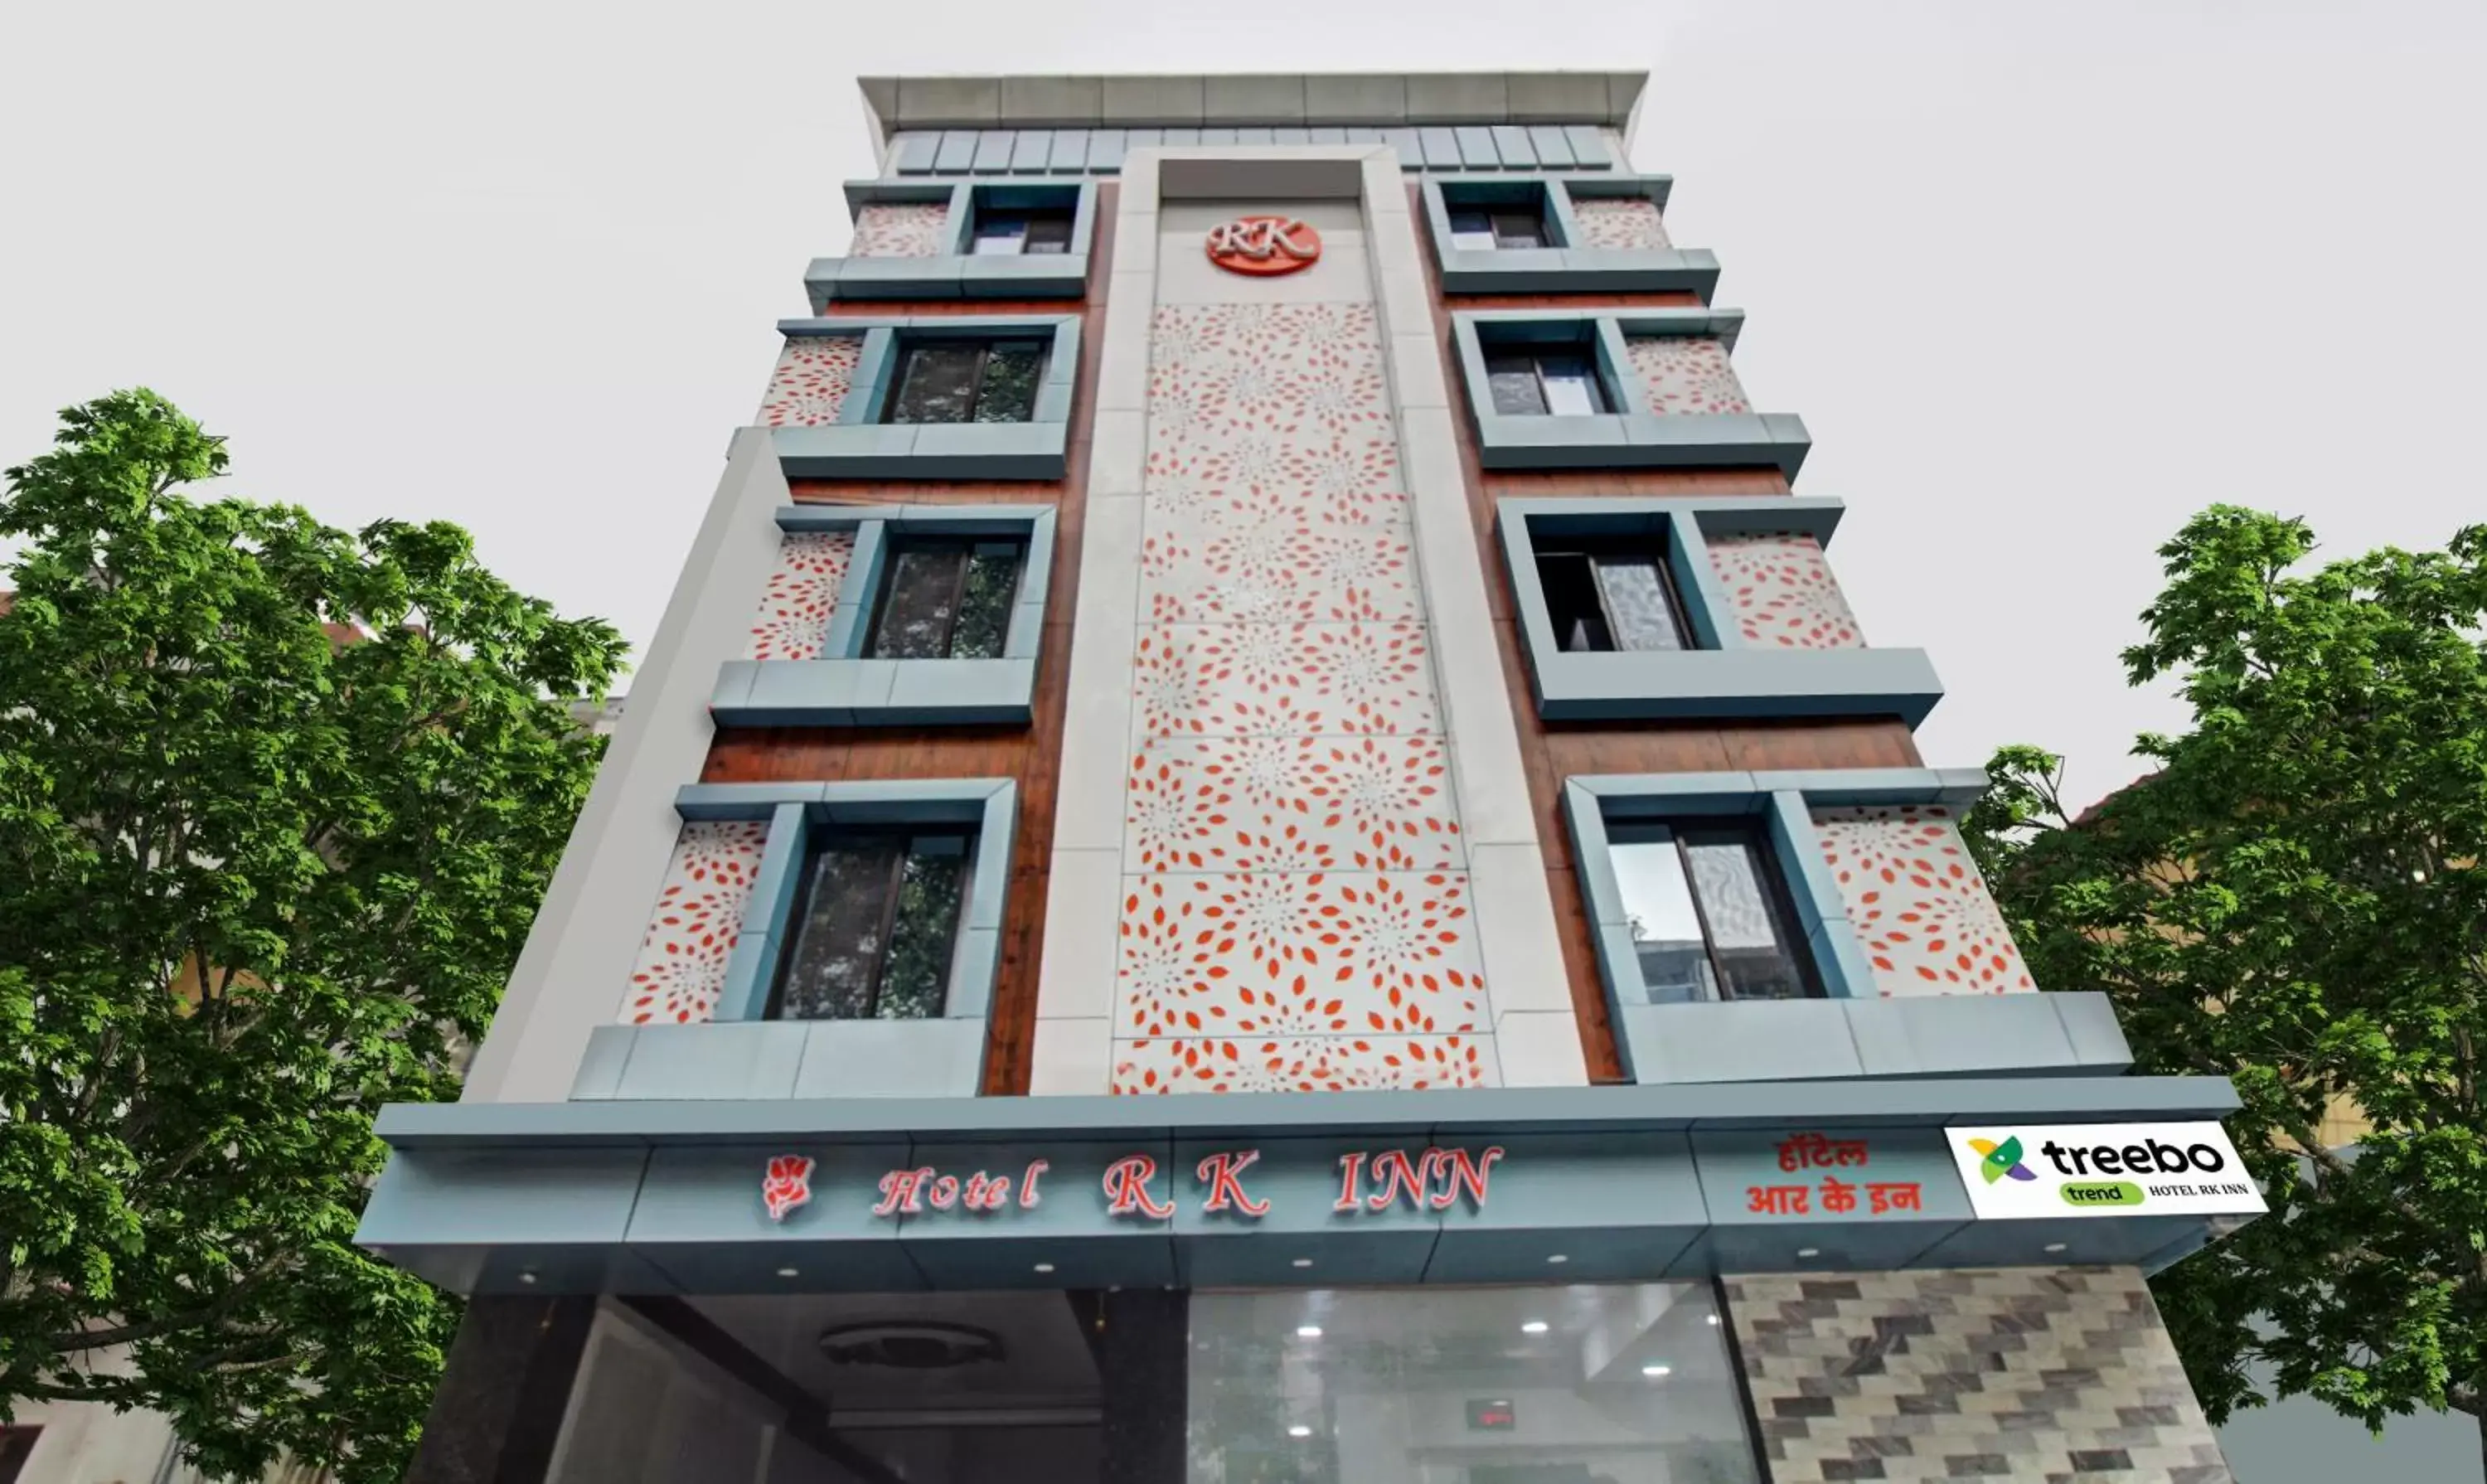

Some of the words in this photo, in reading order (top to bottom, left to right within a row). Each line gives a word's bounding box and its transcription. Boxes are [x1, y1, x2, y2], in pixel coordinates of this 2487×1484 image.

[1207, 219, 1315, 259] RK
[2041, 1138, 2224, 1175] treebo
[873, 1159, 1049, 1216] Hotel
[1334, 1147, 1505, 1210] INN
[1747, 1185, 1810, 1215] आर
[1818, 1175, 1857, 1214] के
[1864, 1181, 1922, 1215] इन
[2068, 1186, 2122, 1201] trend
[2148, 1185, 2198, 1195] HOTEL
[2199, 1184, 2221, 1195] RK
[2222, 1183, 2249, 1195] INN
